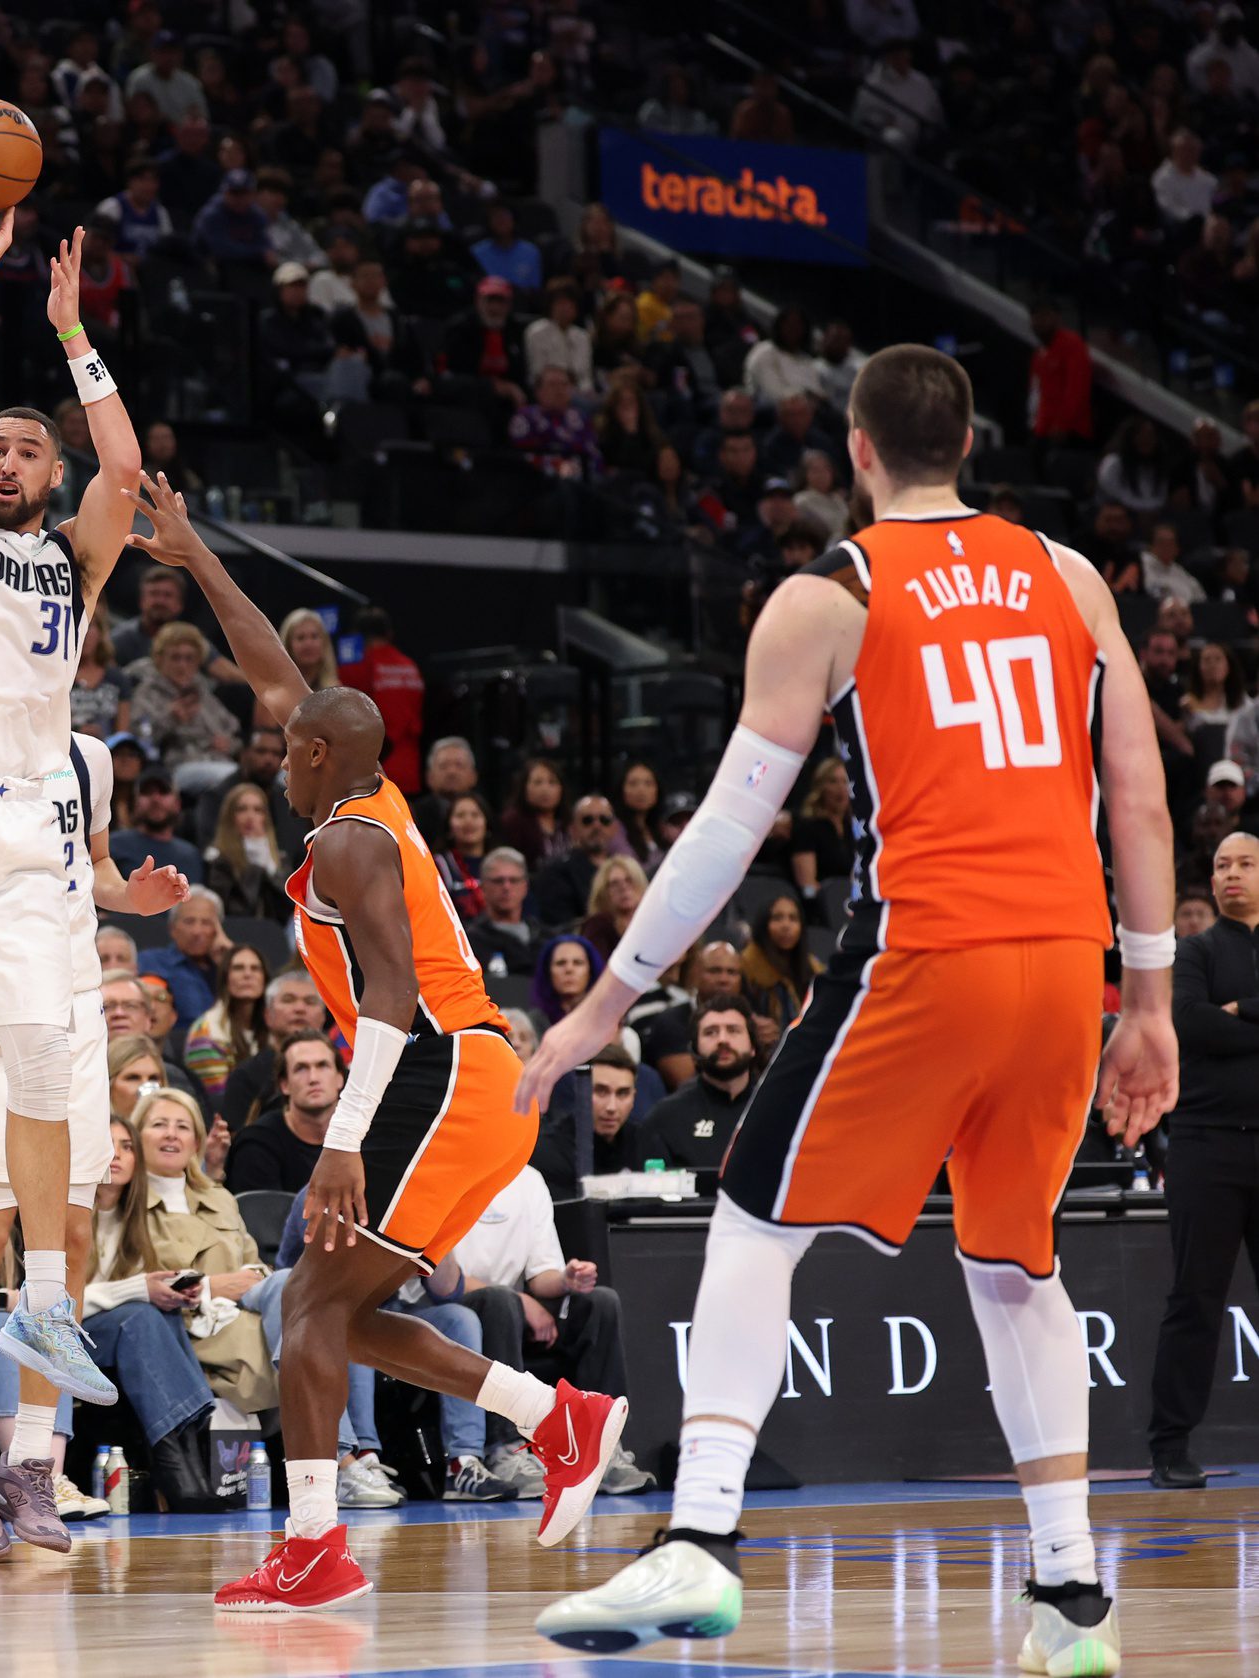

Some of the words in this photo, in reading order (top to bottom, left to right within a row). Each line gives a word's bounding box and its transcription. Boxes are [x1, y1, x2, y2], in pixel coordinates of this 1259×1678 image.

[85, 358, 105, 376] 31
[94, 370, 107, 383] KT
[904, 564, 1032, 621] ZUBAC
[30, 600, 72, 662] 31
[920, 634, 1063, 770] 40
